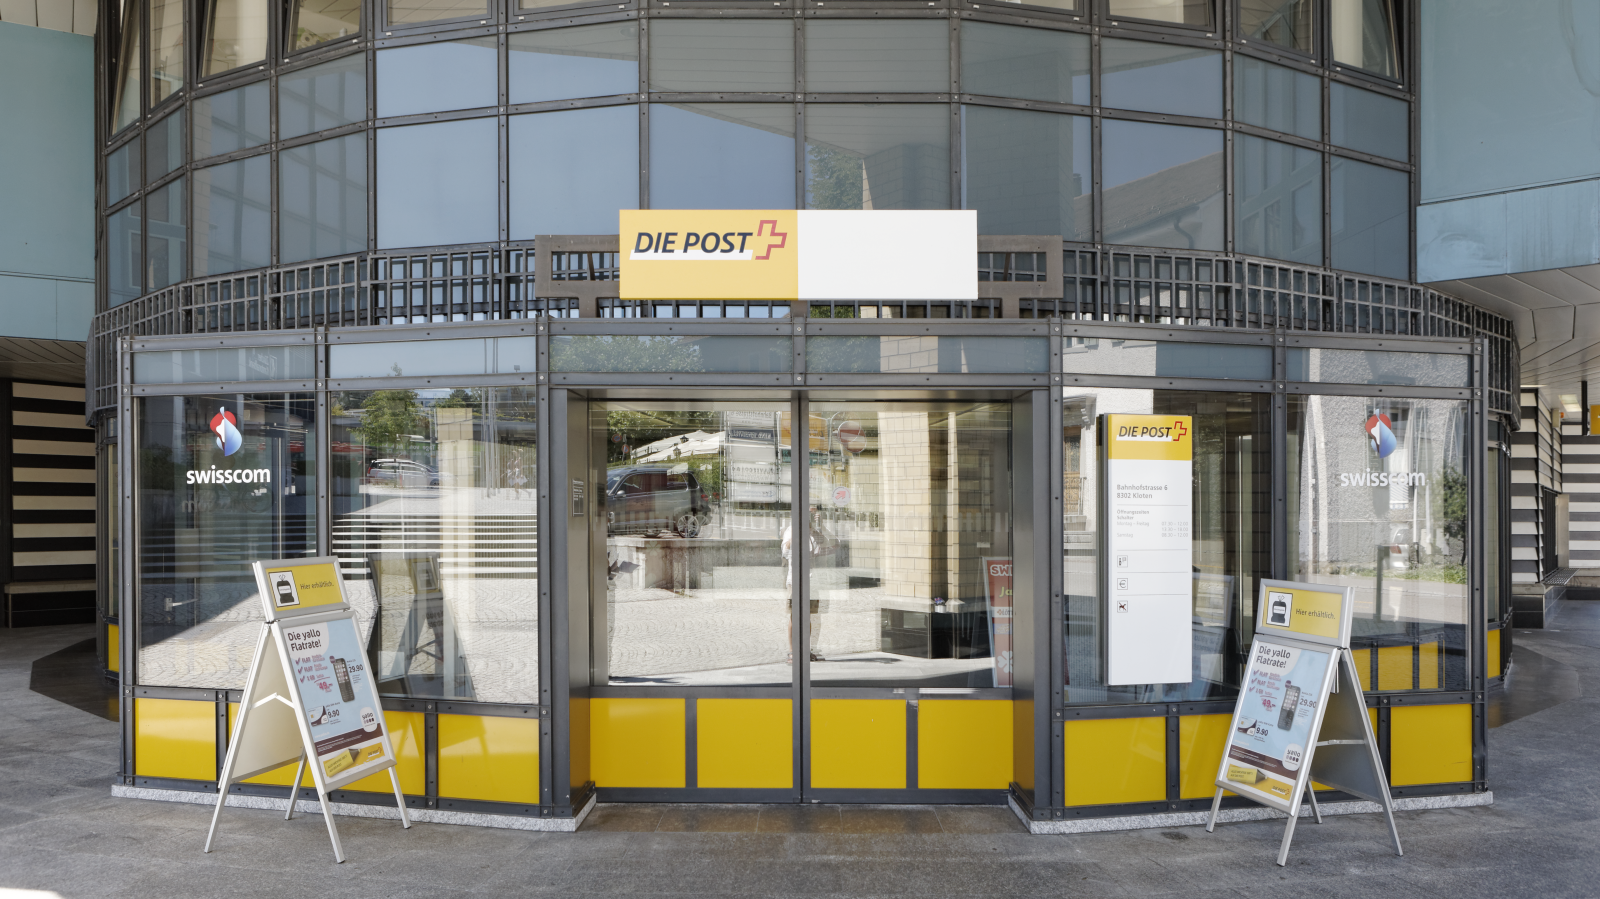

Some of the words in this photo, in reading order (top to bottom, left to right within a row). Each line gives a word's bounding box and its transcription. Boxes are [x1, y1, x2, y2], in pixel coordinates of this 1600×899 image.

[634, 232, 678, 254] DIE
[682, 232, 754, 254] POST
[1118, 426, 1138, 438] DIE
[1141, 427, 1172, 438] POST
[186, 464, 271, 485] swisscom
[1340, 467, 1425, 487] swisscom
[312, 580, 334, 589] erhältlich.
[1295, 608, 1308, 616] Hier
[1308, 609, 1336, 620] erhältlich.
[287, 631, 302, 642] Die
[302, 629, 321, 641] yallo
[290, 639, 322, 652] Flatrate!
[1258, 645, 1271, 655] Die
[1271, 649, 1291, 659] yallo
[1256, 655, 1287, 669] Flatrate!
[348, 664, 364, 674] 29.90
[327, 709, 340, 719] 9.90
[1255, 726, 1269, 737] 9.90
